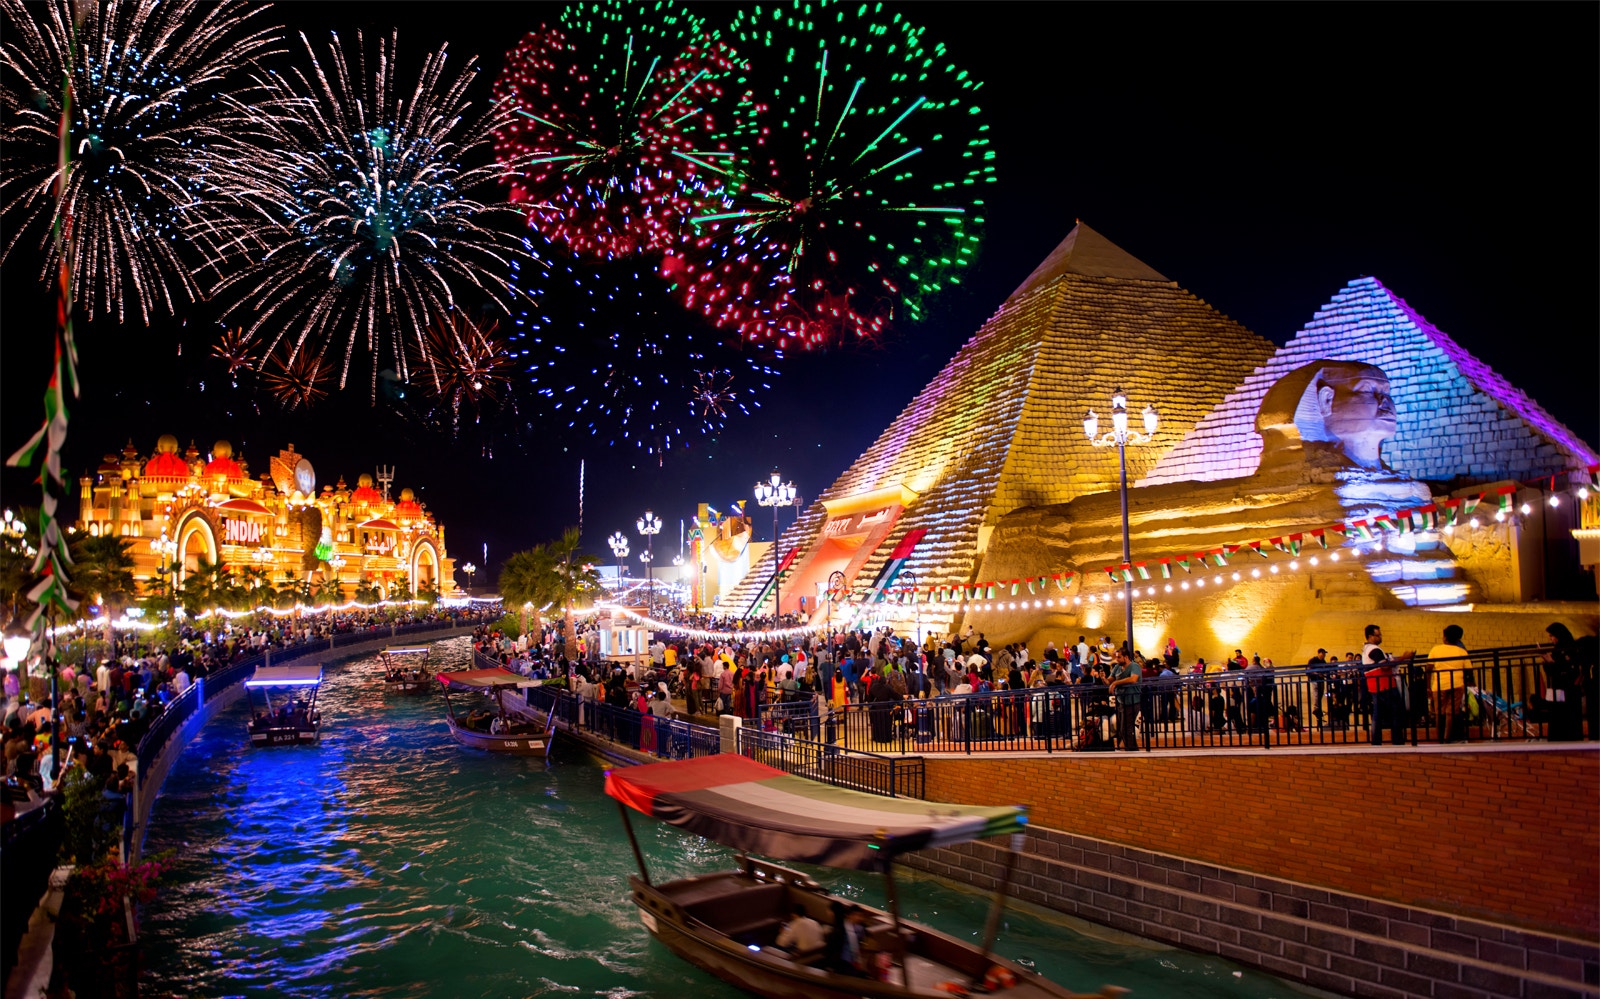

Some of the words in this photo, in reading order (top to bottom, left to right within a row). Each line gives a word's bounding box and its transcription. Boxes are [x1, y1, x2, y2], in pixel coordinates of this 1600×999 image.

[225, 518, 260, 543] INDIA
[824, 517, 853, 534] EGYPT
[366, 535, 393, 555] الهند
